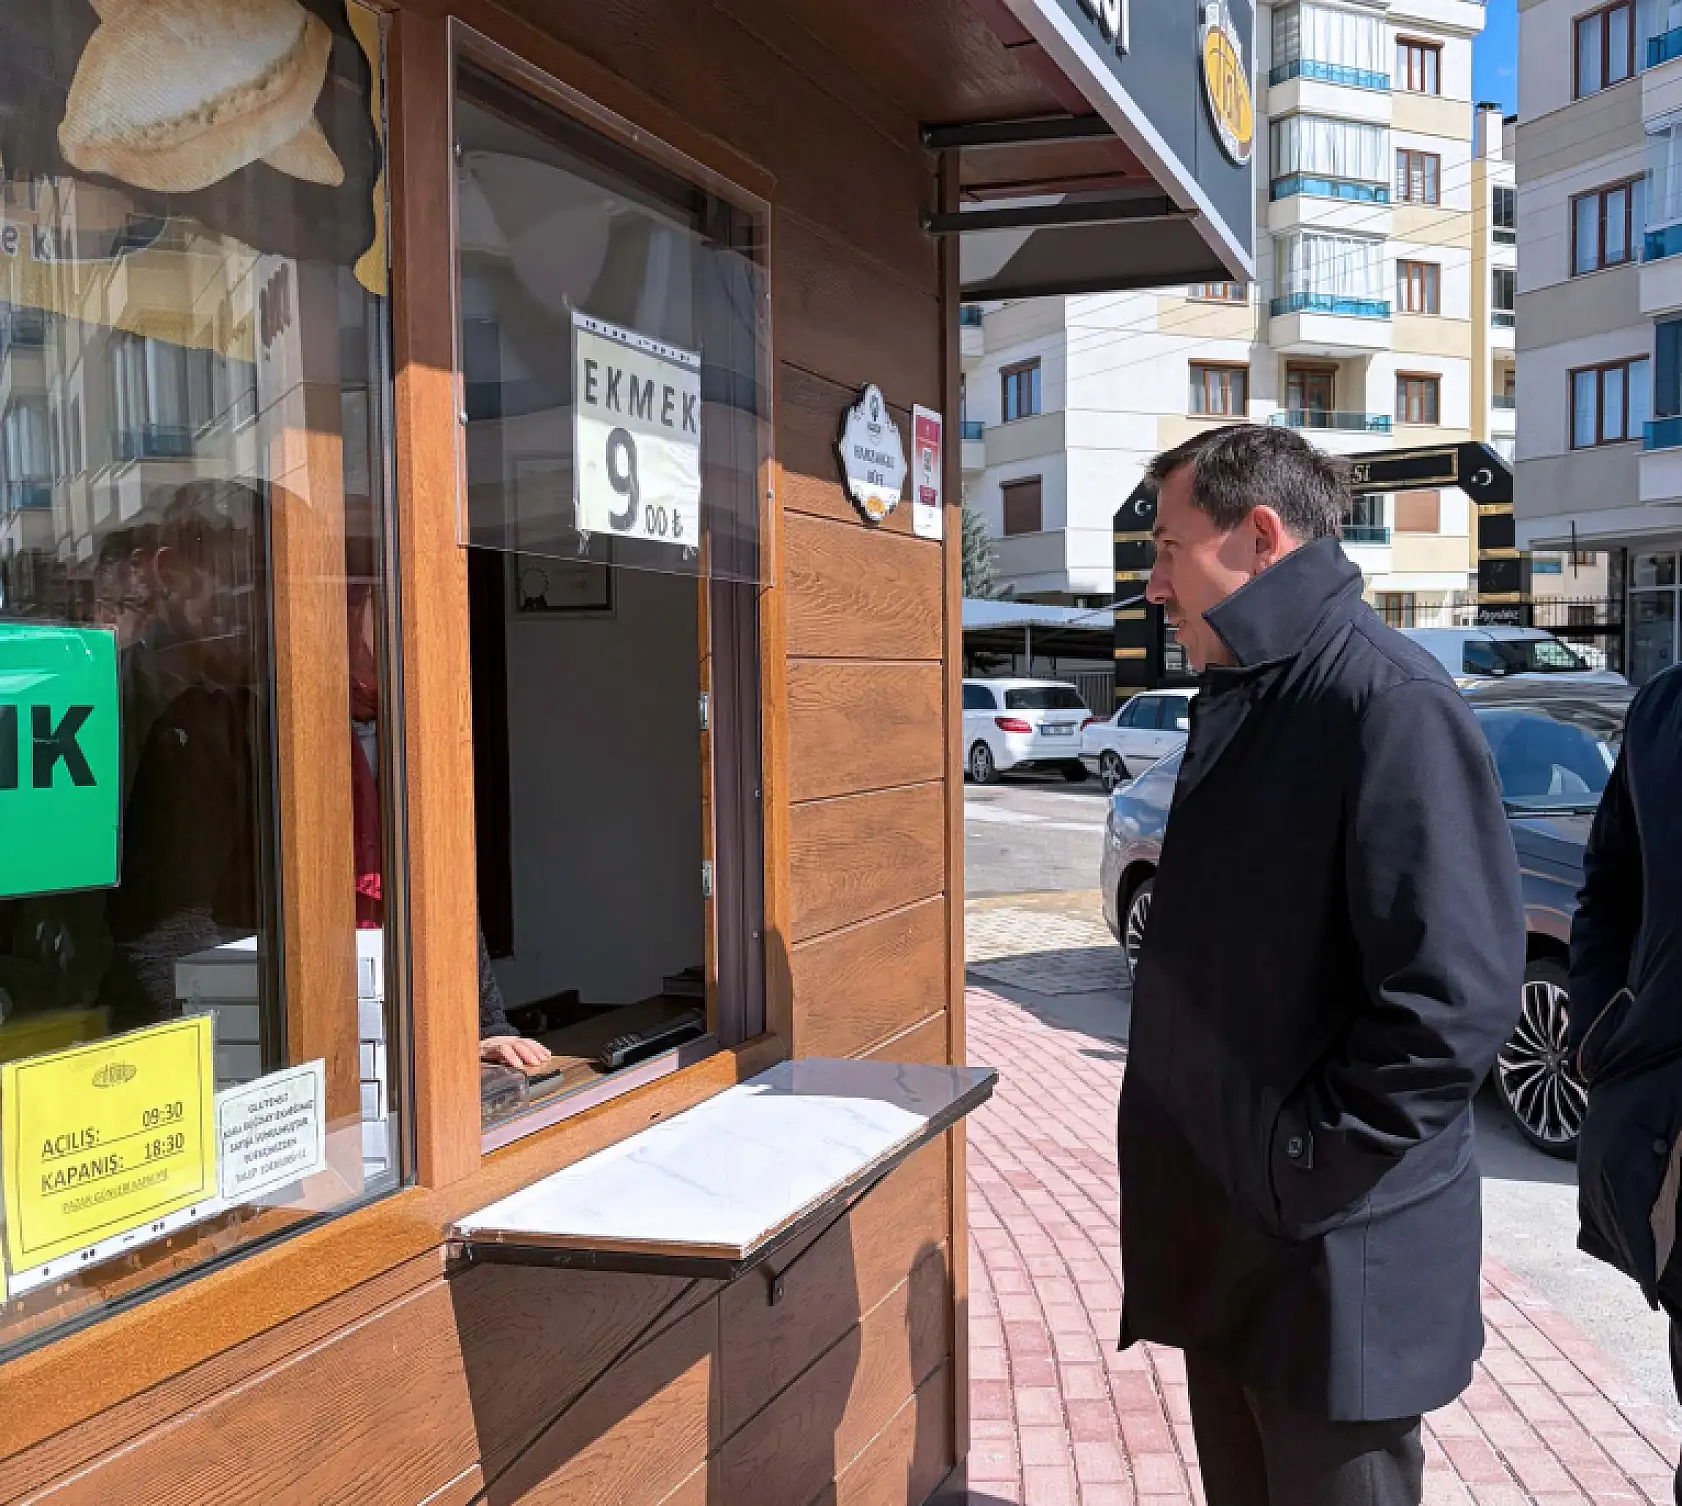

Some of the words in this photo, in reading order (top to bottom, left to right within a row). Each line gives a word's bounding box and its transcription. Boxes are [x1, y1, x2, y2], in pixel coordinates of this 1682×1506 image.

[583, 358, 697, 434] EKMEK
[142, 1101, 184, 1127] 09:30
[41, 1153, 124, 1193] KAPANIŞ:
[144, 1132, 185, 1160] 18:30
